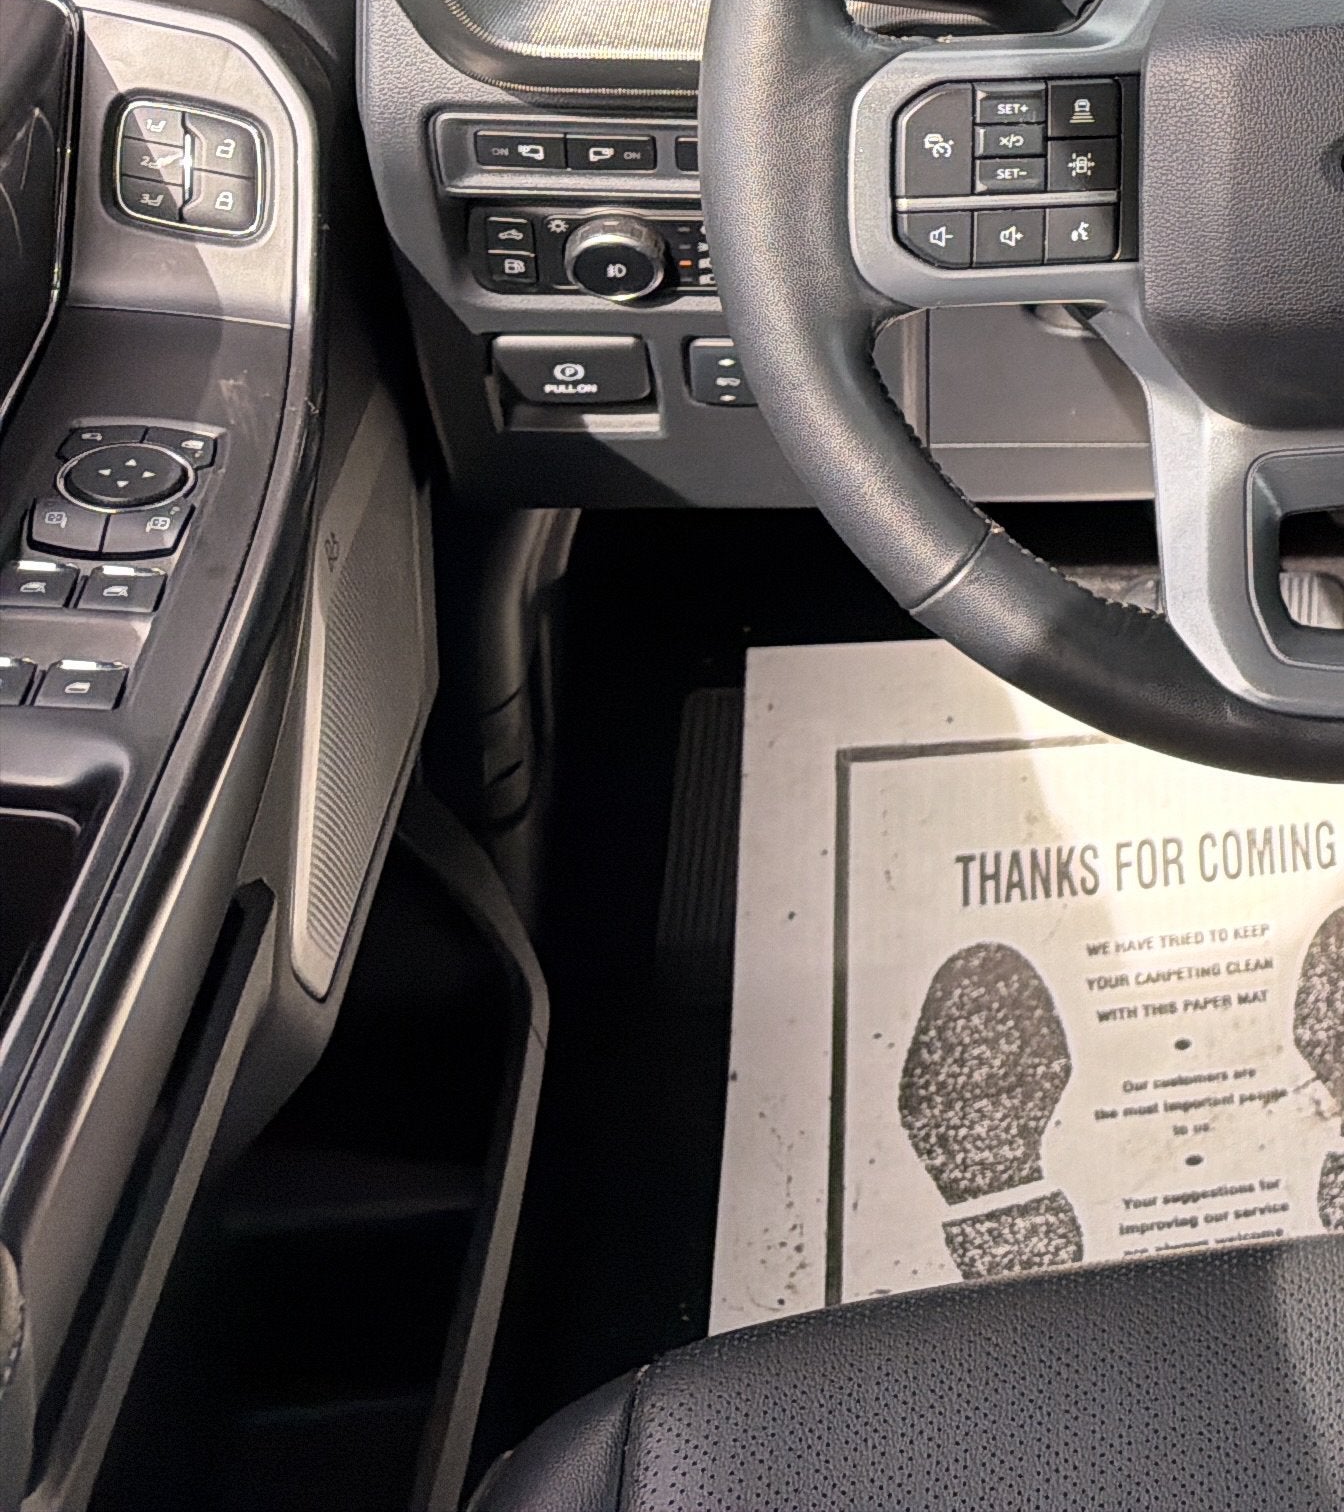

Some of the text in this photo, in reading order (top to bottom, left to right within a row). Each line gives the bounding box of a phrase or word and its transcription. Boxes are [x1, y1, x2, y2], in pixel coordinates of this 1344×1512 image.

[997, 104, 1029, 115] SET+
[955, 843, 1100, 907] THANKS
[1115, 837, 1186, 891] FOR
[1199, 820, 1337, 883] COMING
[1086, 923, 1270, 956] WE HAVE TRIED TO KEEP
[1086, 957, 1274, 991] YOUR CARPETING CLEAN
[1097, 989, 1269, 1023] WITH THIS PAPER MAT
[1122, 1068, 1256, 1093] Our customers are
[1094, 1108, 1118, 1120] the
[1123, 1102, 1158, 1116] most
[1164, 1093, 1234, 1112] important
[1122, 1179, 1281, 1209] Your suggestions for
[1119, 1202, 1290, 1235] improving our service
